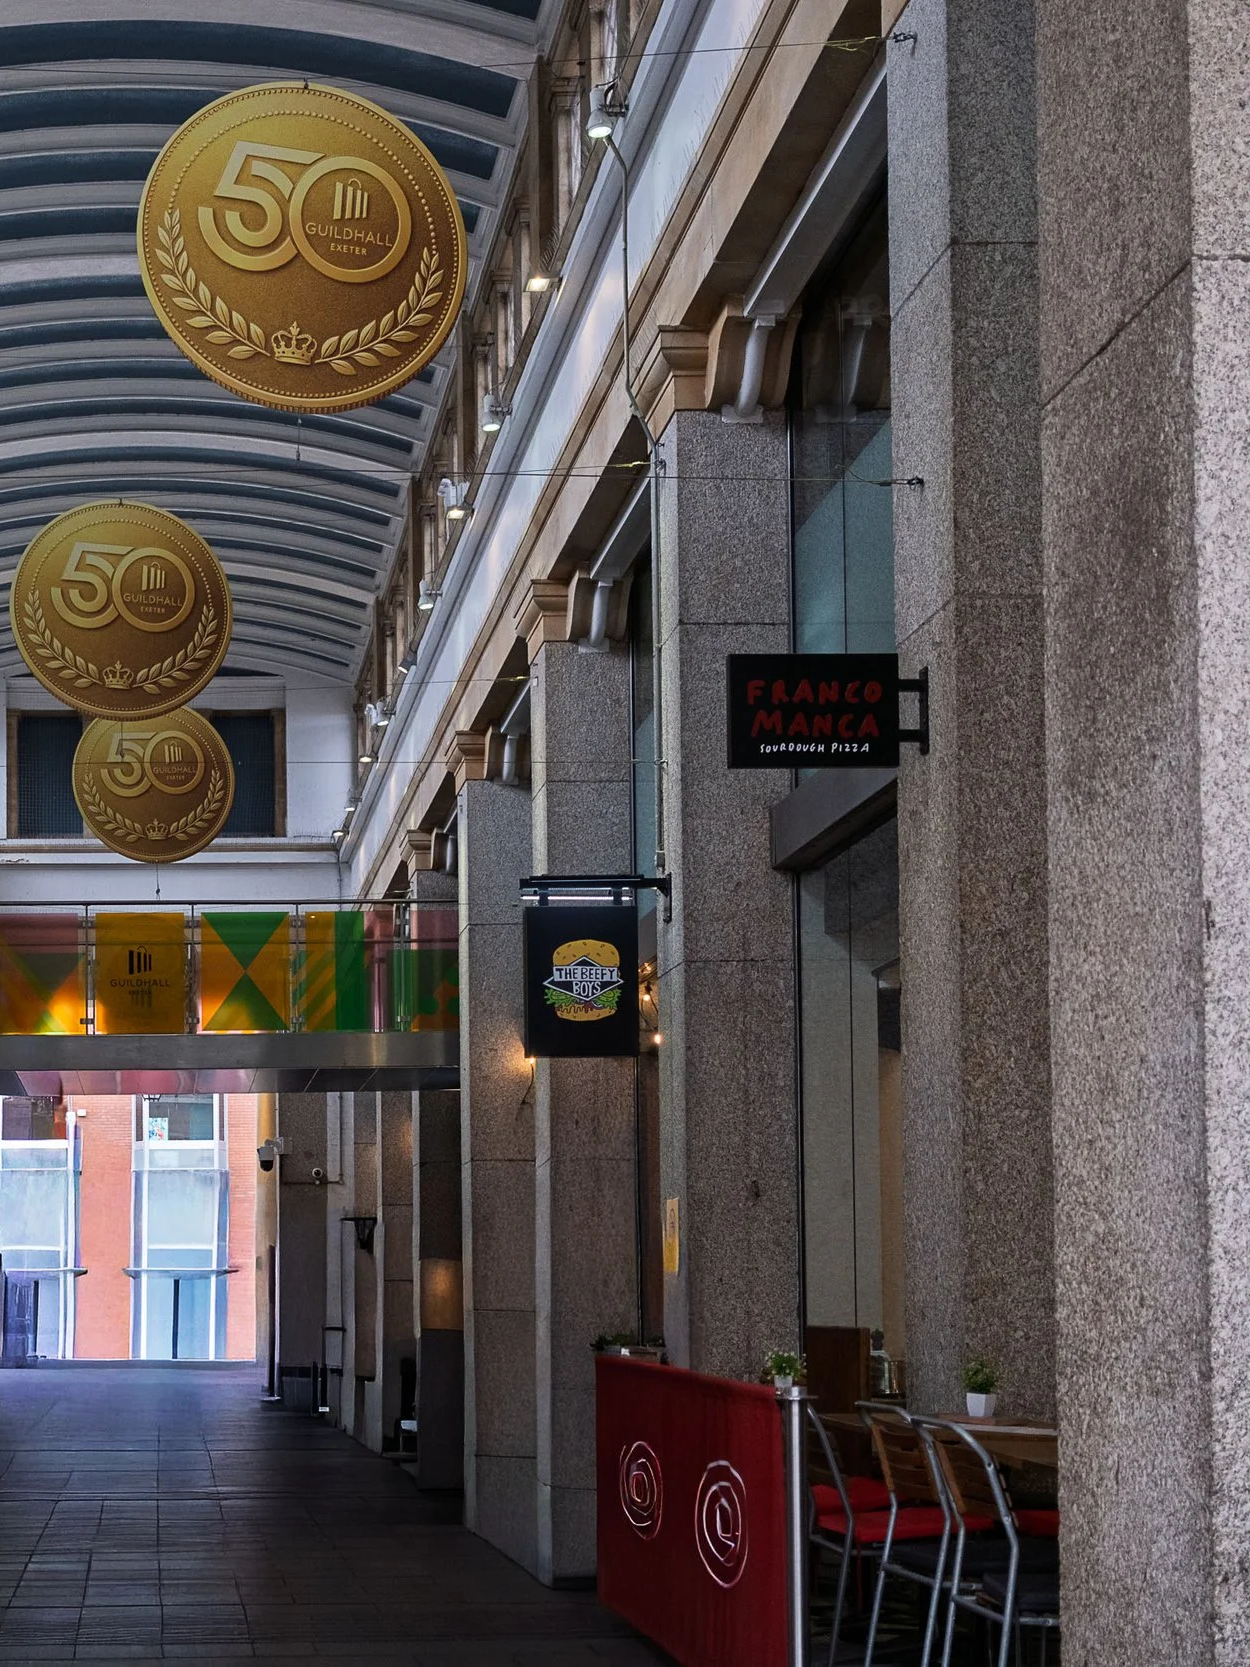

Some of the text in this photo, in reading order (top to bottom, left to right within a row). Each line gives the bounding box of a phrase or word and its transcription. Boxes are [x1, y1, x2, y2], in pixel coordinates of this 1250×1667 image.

[198, 141, 412, 283] 50
[305, 223, 393, 247] GUILDHALL
[330, 244, 367, 256] EXETER
[51, 541, 196, 632] 50
[123, 593, 182, 606] GUILDHALL
[747, 679, 883, 705] FRANCO
[751, 710, 879, 738] MANCA
[760, 742, 870, 753] SOURDOUGH PIZZA
[101, 731, 205, 795] 50
[153, 766, 196, 774] GUILDHALL
[555, 968, 616, 980] THE BEEFY
[110, 979, 170, 987] GUILDHALL
[573, 981, 601, 996] BOYS
